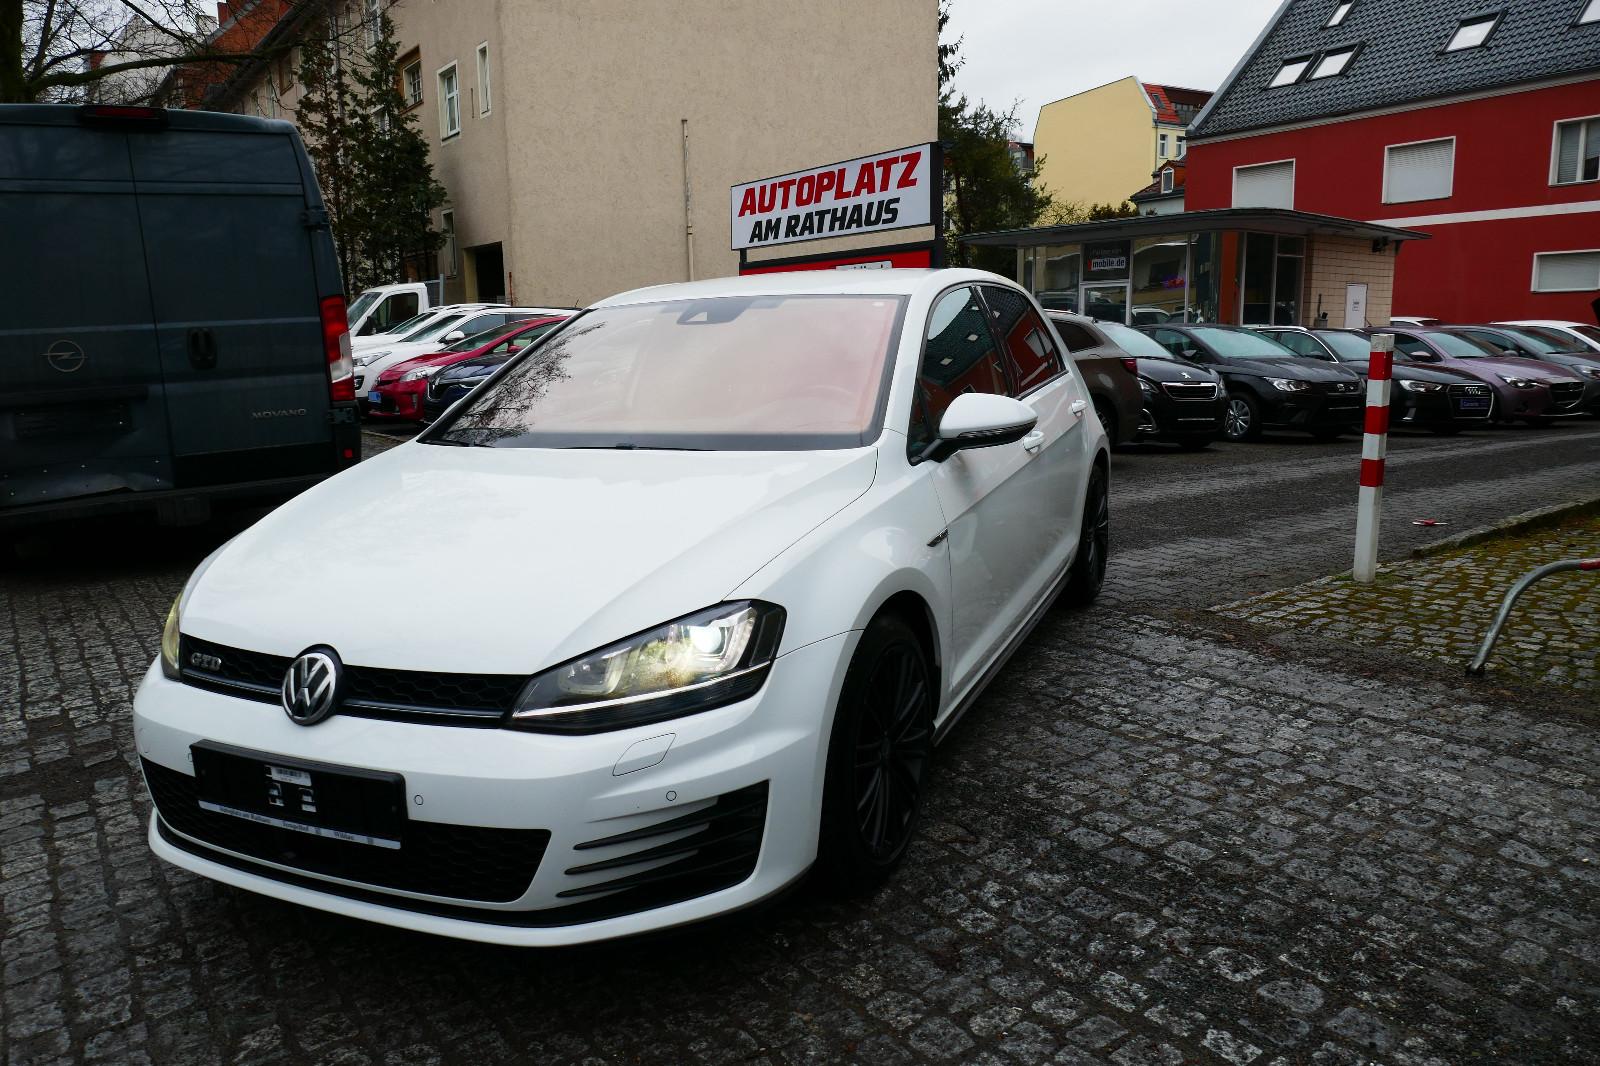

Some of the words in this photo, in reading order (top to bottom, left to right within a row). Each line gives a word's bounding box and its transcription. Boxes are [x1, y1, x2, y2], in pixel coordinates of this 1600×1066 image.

[738, 151, 922, 217] AUTOPLATZ
[749, 216, 782, 243] AM
[784, 197, 900, 239] RATHAUS
[1092, 258, 1125, 269] mobile.de
[251, 408, 306, 419] MOVANO
[191, 652, 222, 671] GTD
